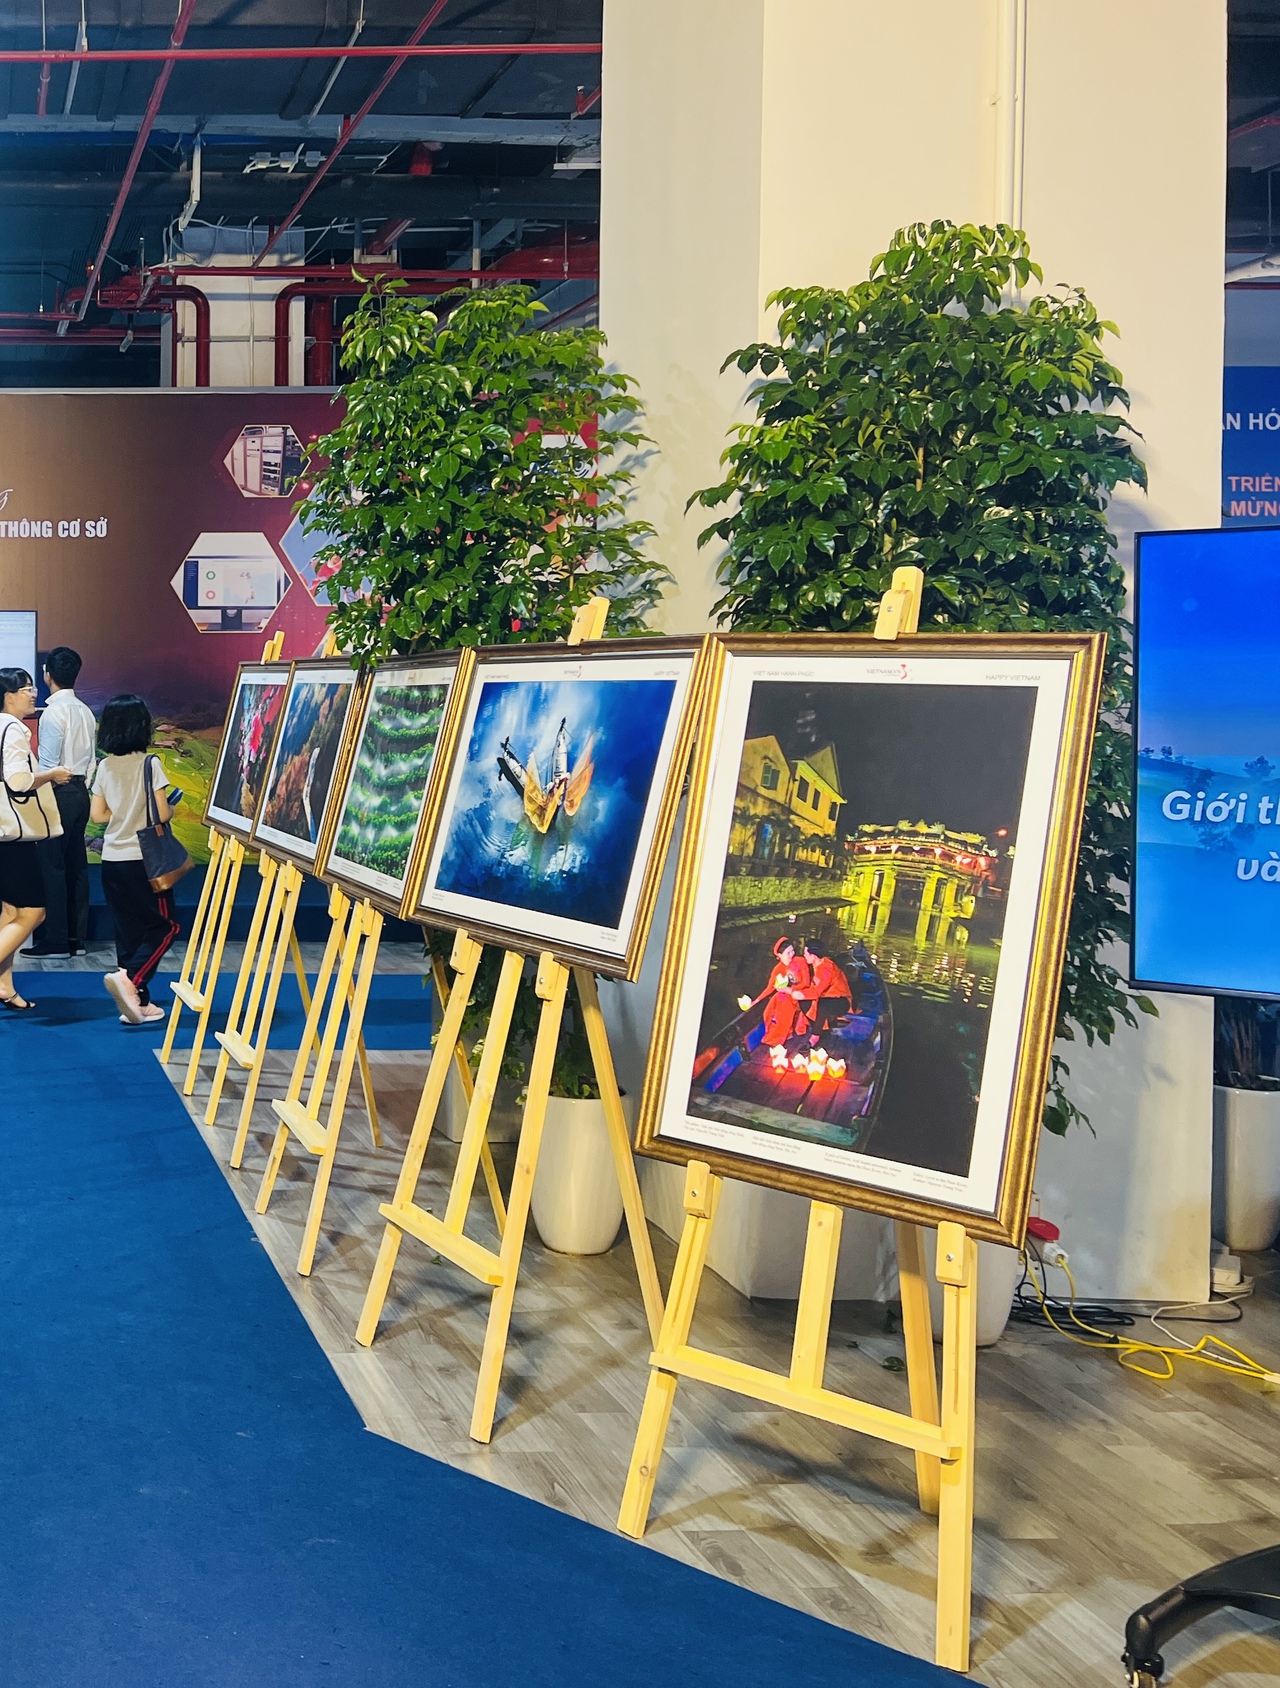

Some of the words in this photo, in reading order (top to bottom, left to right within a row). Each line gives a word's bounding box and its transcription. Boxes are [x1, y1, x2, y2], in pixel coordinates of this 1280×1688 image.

[1221, 412, 1241, 430] N
[1230, 496, 1280, 517] MỪN
[56, 518, 82, 539] CƠ
[84, 516, 109, 539] SỞ
[1162, 790, 1249, 824] Giới
[1258, 794, 1280, 825] t
[1236, 851, 1280, 883] và
